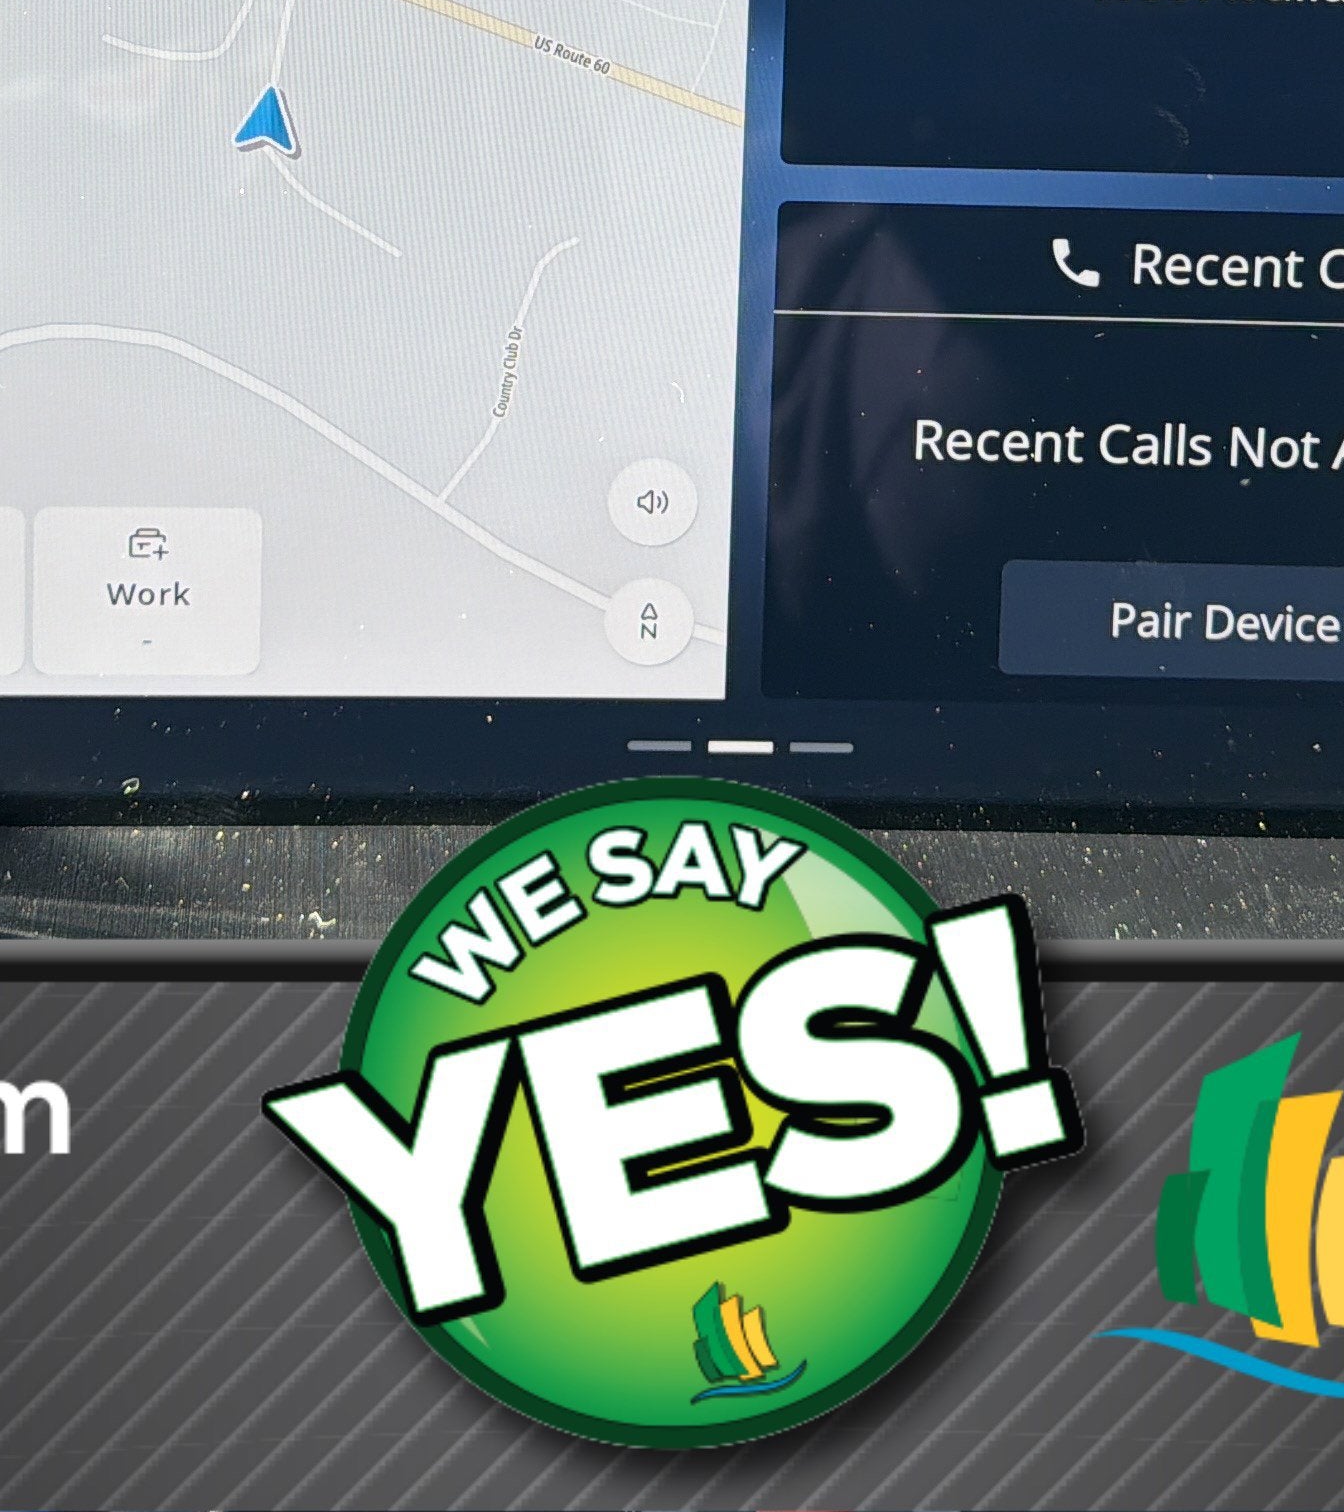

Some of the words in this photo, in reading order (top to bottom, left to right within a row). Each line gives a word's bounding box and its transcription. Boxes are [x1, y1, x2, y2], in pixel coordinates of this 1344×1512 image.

[535, 35, 553, 52] US
[553, 44, 591, 68] Route
[594, 59, 610, 74] 60
[1134, 244, 1304, 288] Recent
[508, 326, 522, 340] Dr
[504, 343, 518, 369] Club
[493, 372, 517, 417] Country
[916, 420, 1084, 463] Recent
[1100, 423, 1211, 466] Calls
[1231, 427, 1320, 468] Not
[106, 581, 191, 606] Work
[641, 623, 657, 639] N
[1112, 602, 1192, 640] Pair
[1206, 605, 1341, 643] Device
